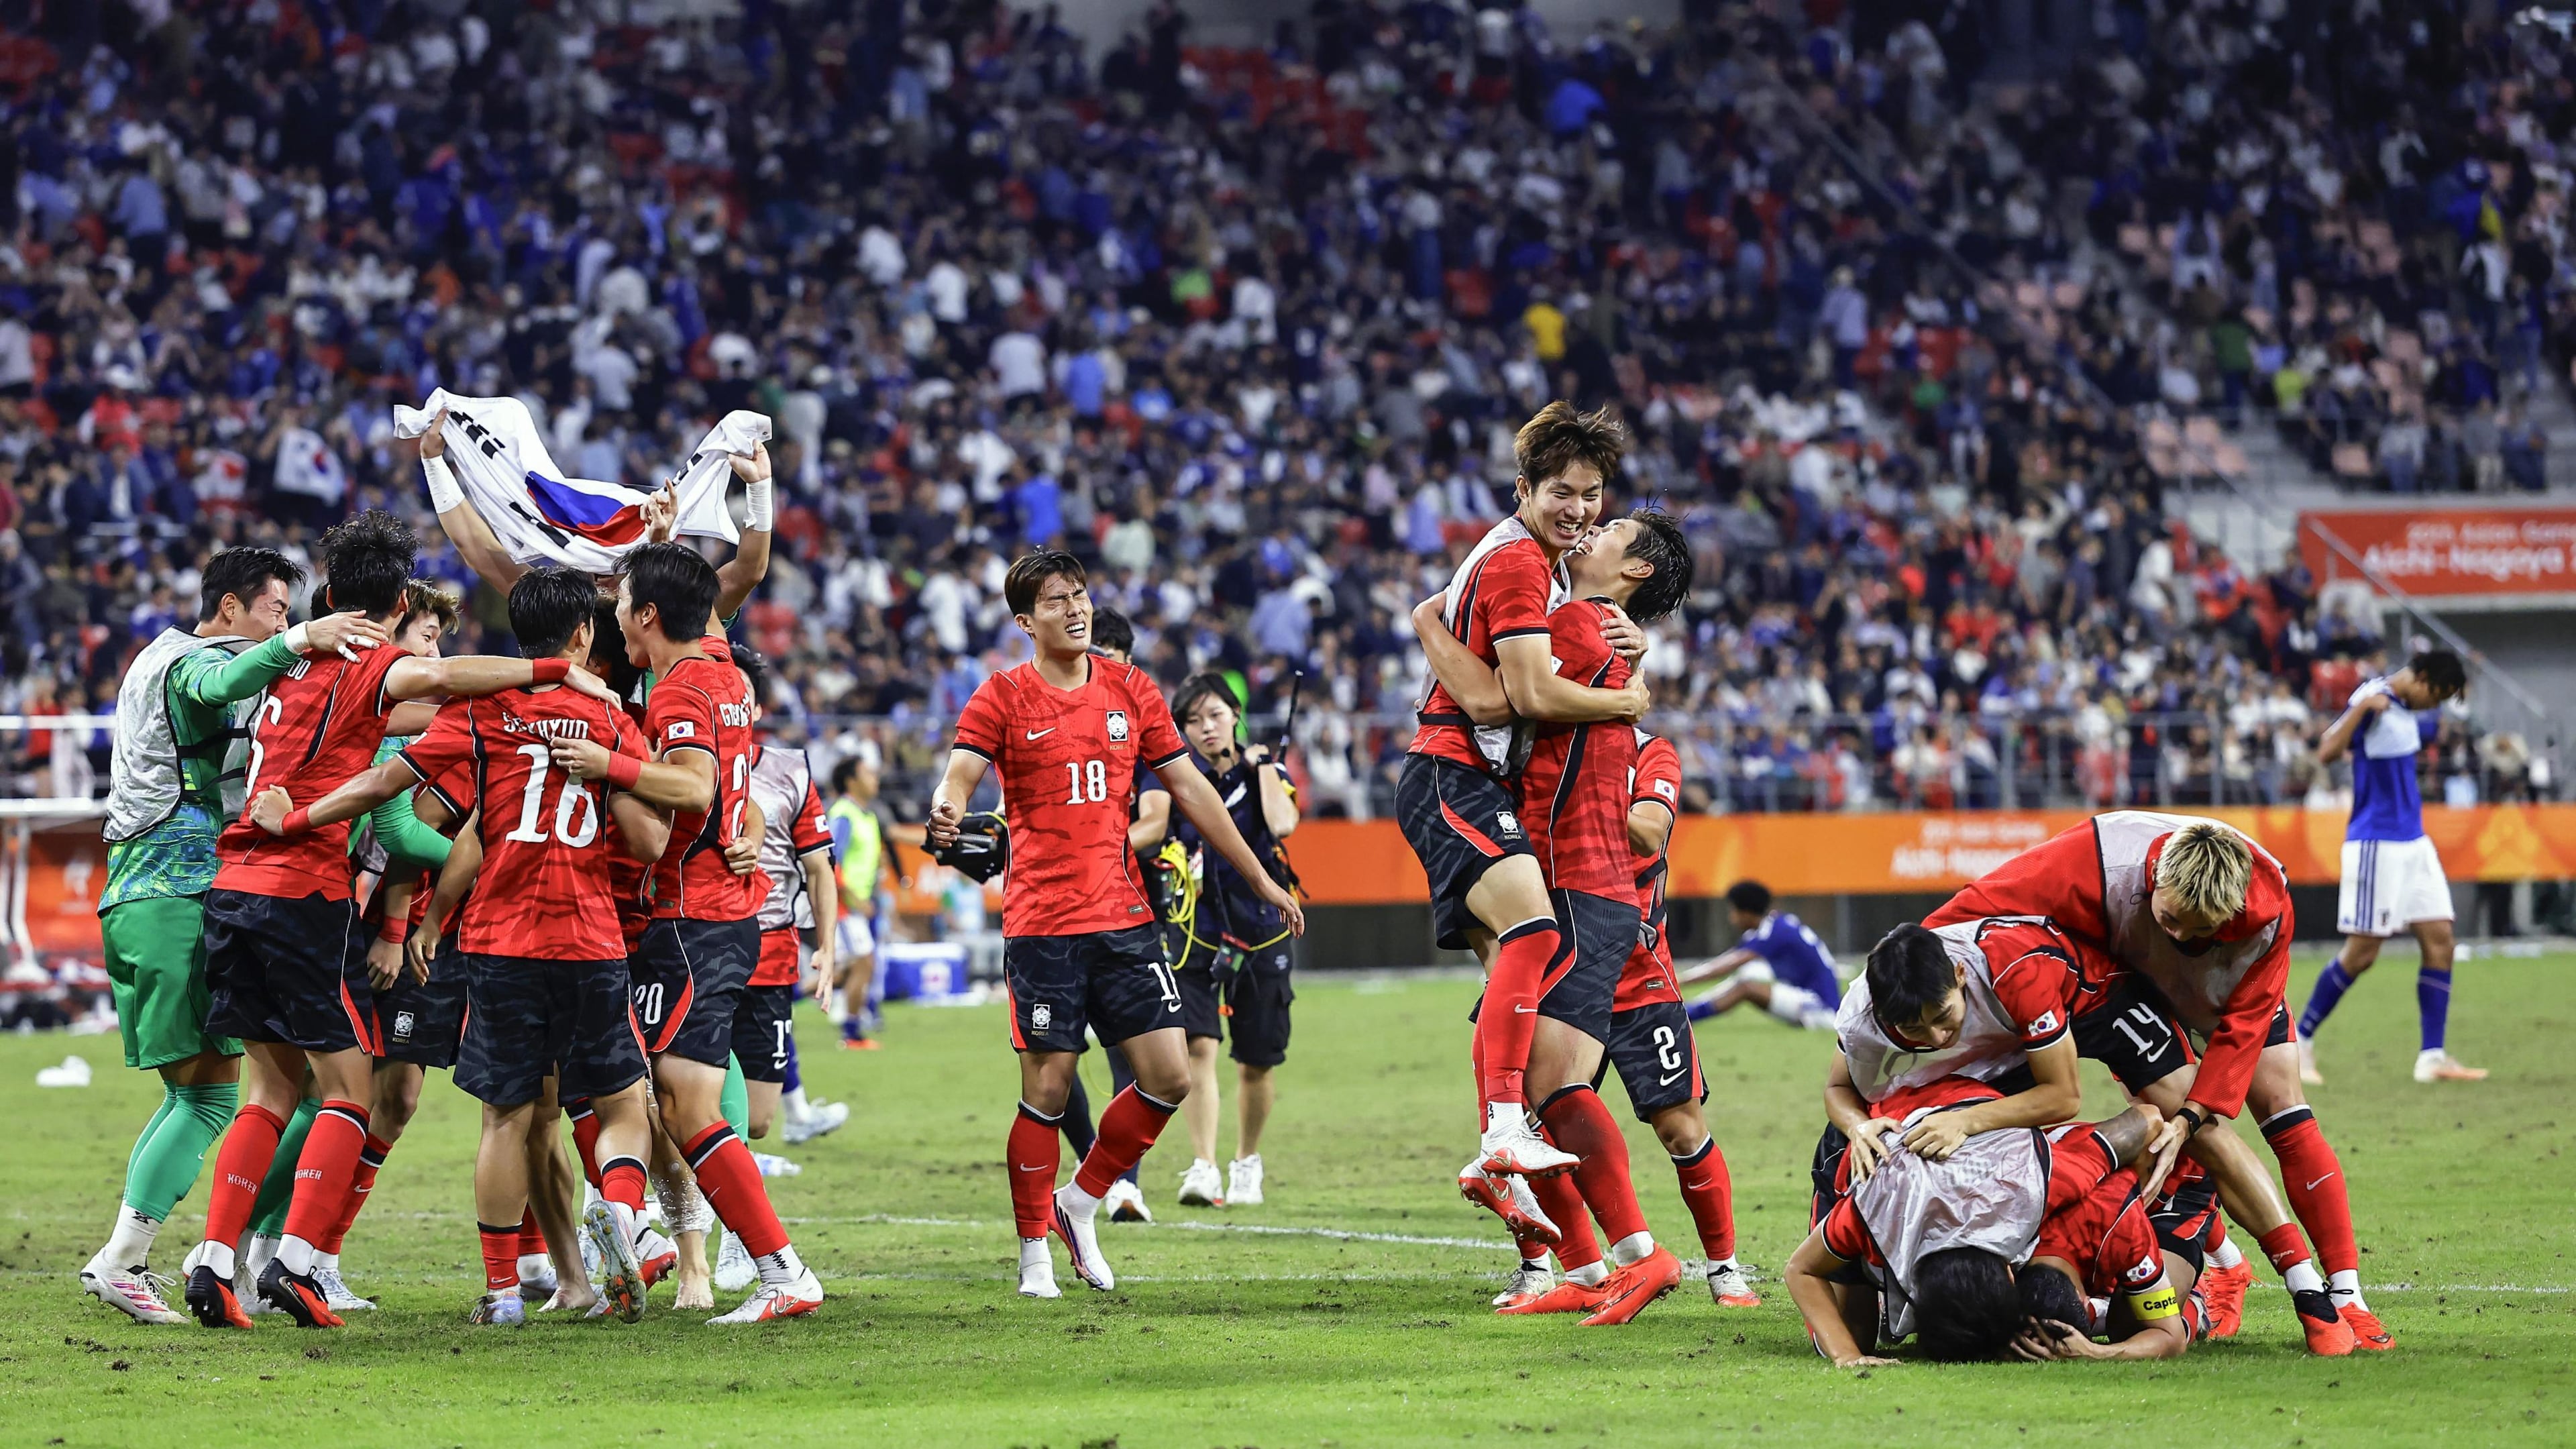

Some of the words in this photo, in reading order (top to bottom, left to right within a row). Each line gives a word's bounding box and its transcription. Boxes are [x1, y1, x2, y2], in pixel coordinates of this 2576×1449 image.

[506, 743, 598, 849] 16
[1065, 759, 1108, 806] 18
[1653, 1026, 1682, 1070] 2
[2112, 1002, 2172, 1057] 14
